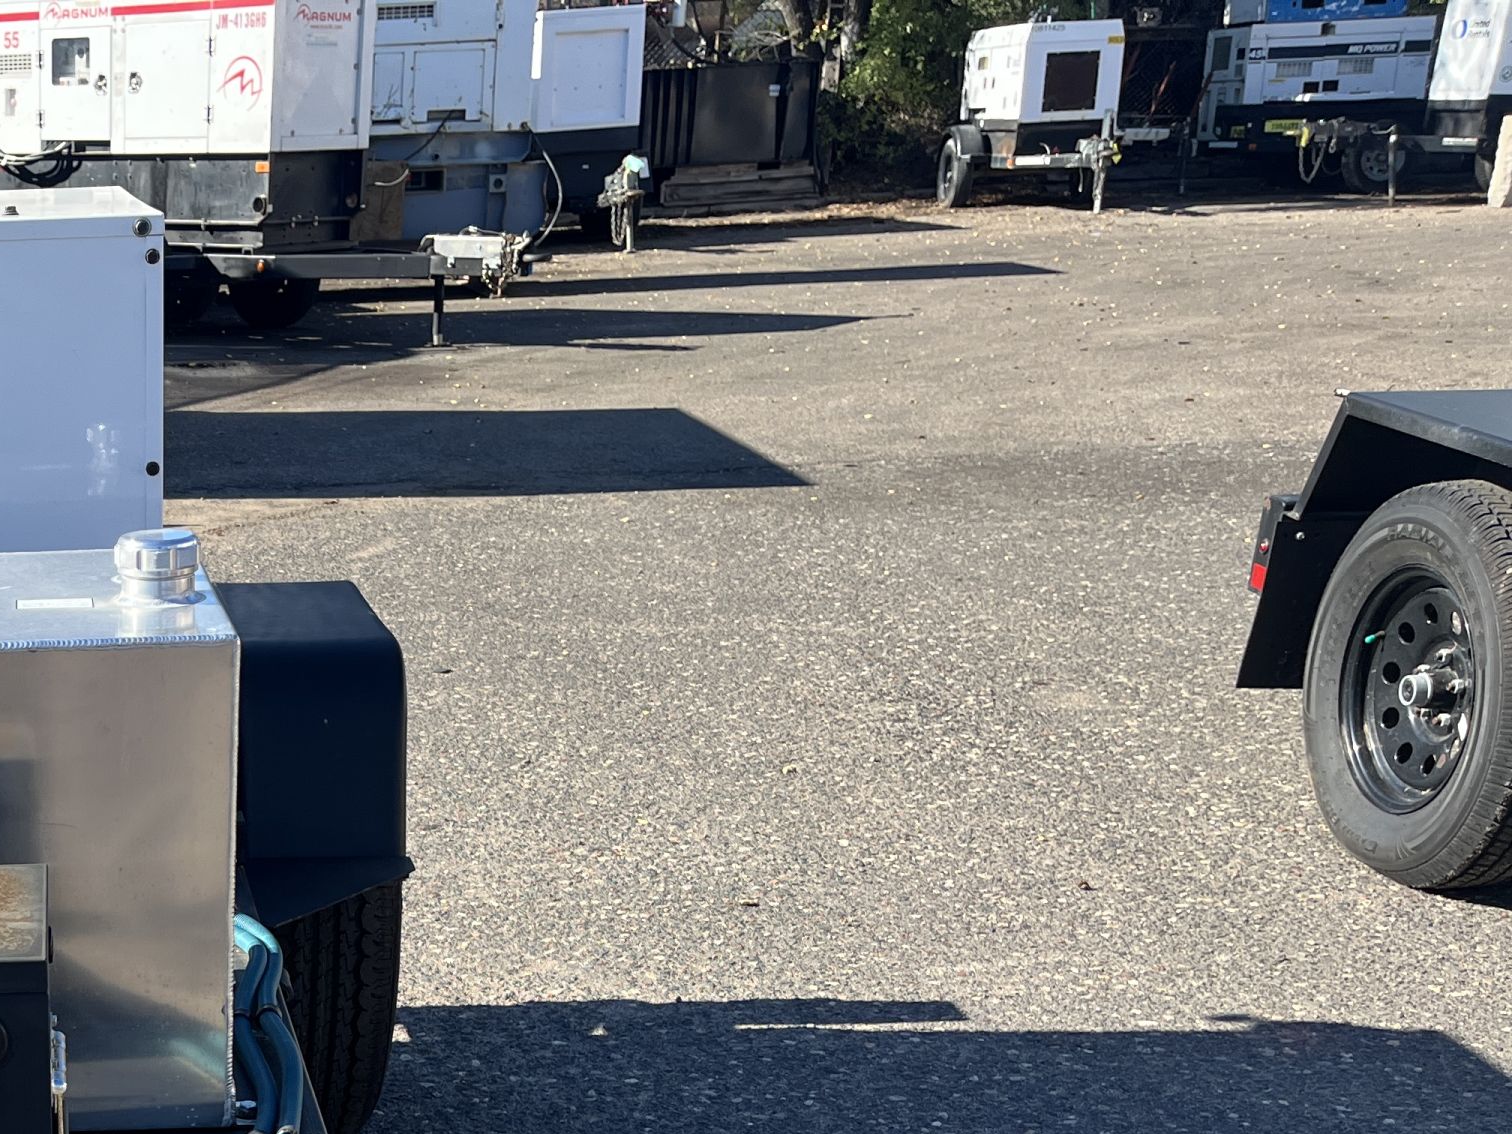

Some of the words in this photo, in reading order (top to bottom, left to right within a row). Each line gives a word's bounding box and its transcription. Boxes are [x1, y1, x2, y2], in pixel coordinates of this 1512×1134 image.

[294, 8, 352, 22] MAGNUM
[3, 31, 19, 49] 55
[1363, 43, 1397, 53] POWER
